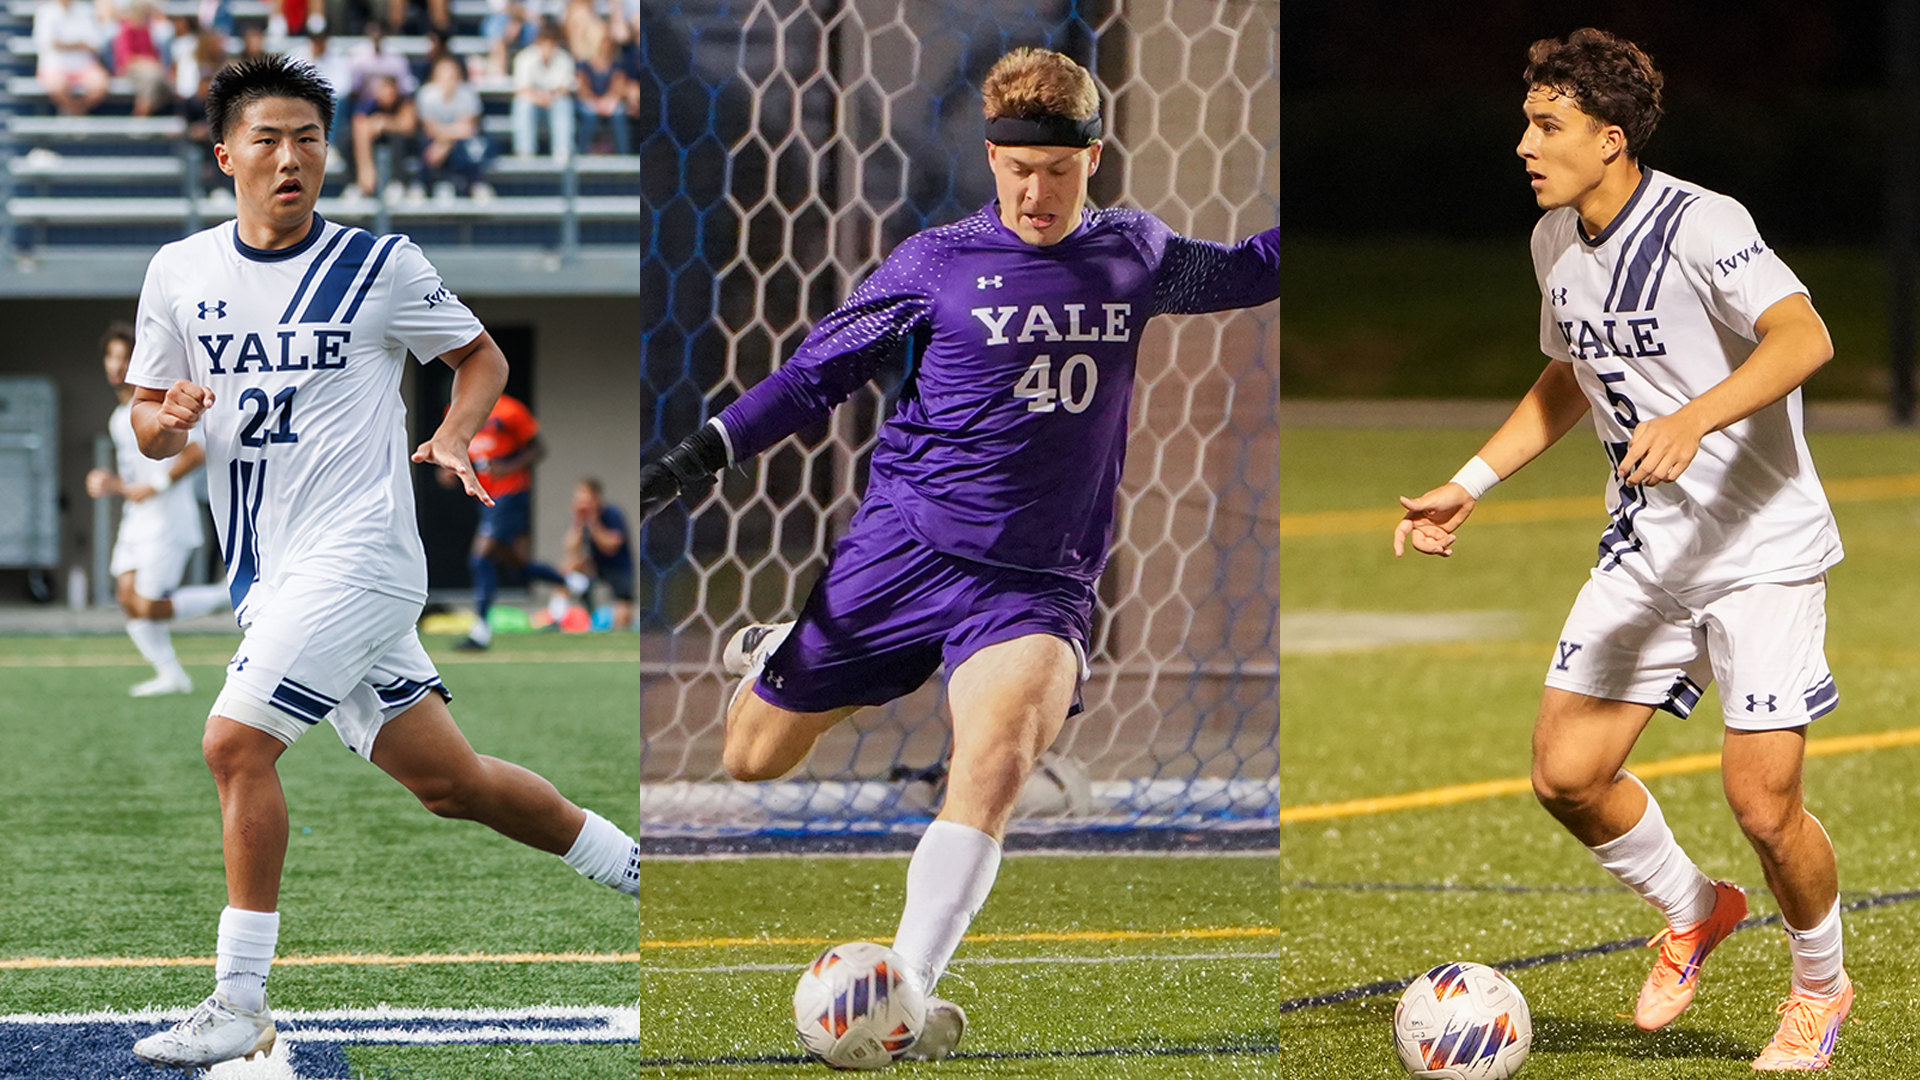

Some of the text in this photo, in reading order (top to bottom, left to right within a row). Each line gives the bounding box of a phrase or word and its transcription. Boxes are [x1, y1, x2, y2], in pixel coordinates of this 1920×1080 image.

[971, 303, 1131, 345] YALE
[1557, 317, 1666, 360] YALE
[197, 330, 351, 375] YALE
[1013, 353, 1098, 414] 40
[1597, 371, 1641, 429] 5
[238, 386, 299, 448] 21
[1556, 641, 1583, 671] Y
